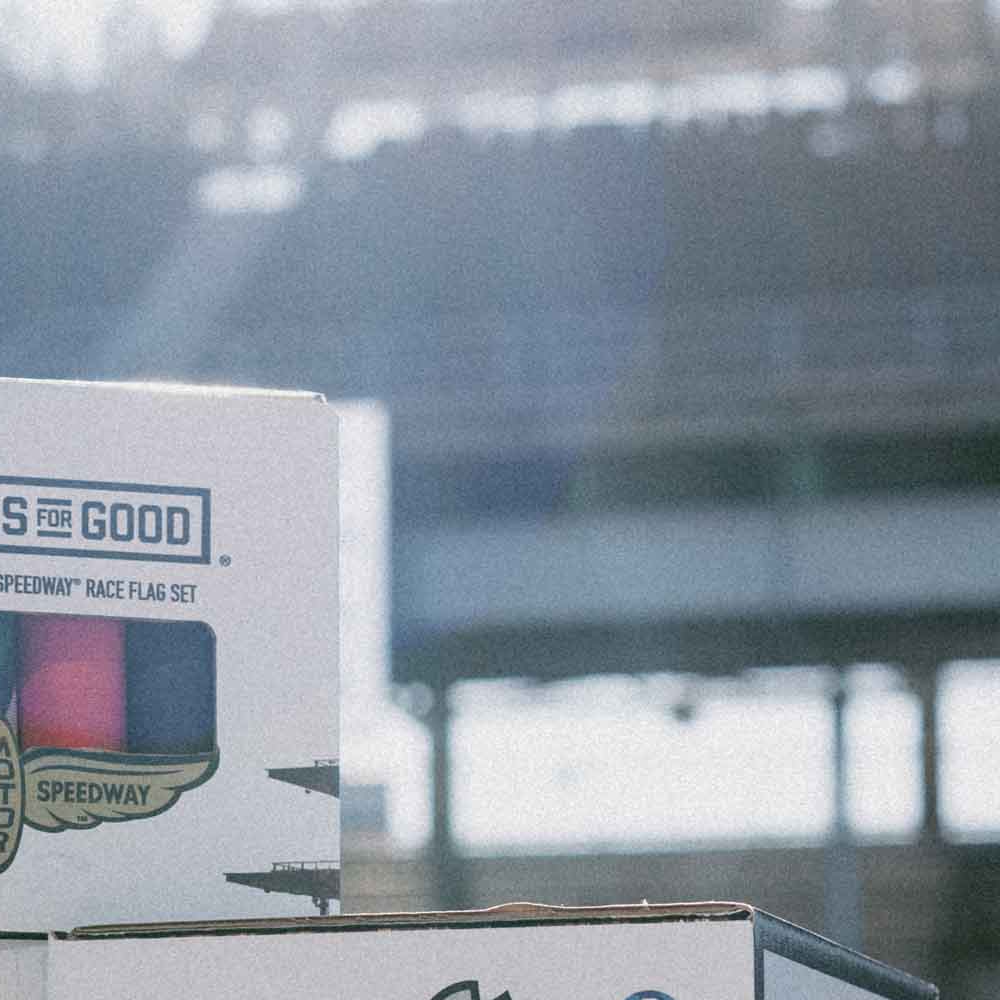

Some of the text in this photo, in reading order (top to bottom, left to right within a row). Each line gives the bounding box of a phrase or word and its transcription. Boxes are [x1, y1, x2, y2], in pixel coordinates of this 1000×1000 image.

[37, 509, 72, 528] FOR
[82, 501, 190, 545] GOOD
[86, 579, 124, 599] RACE
[129, 581, 166, 601] FLAG
[171, 584, 197, 603] SET
[37, 780, 150, 805] SPEEDWAY
